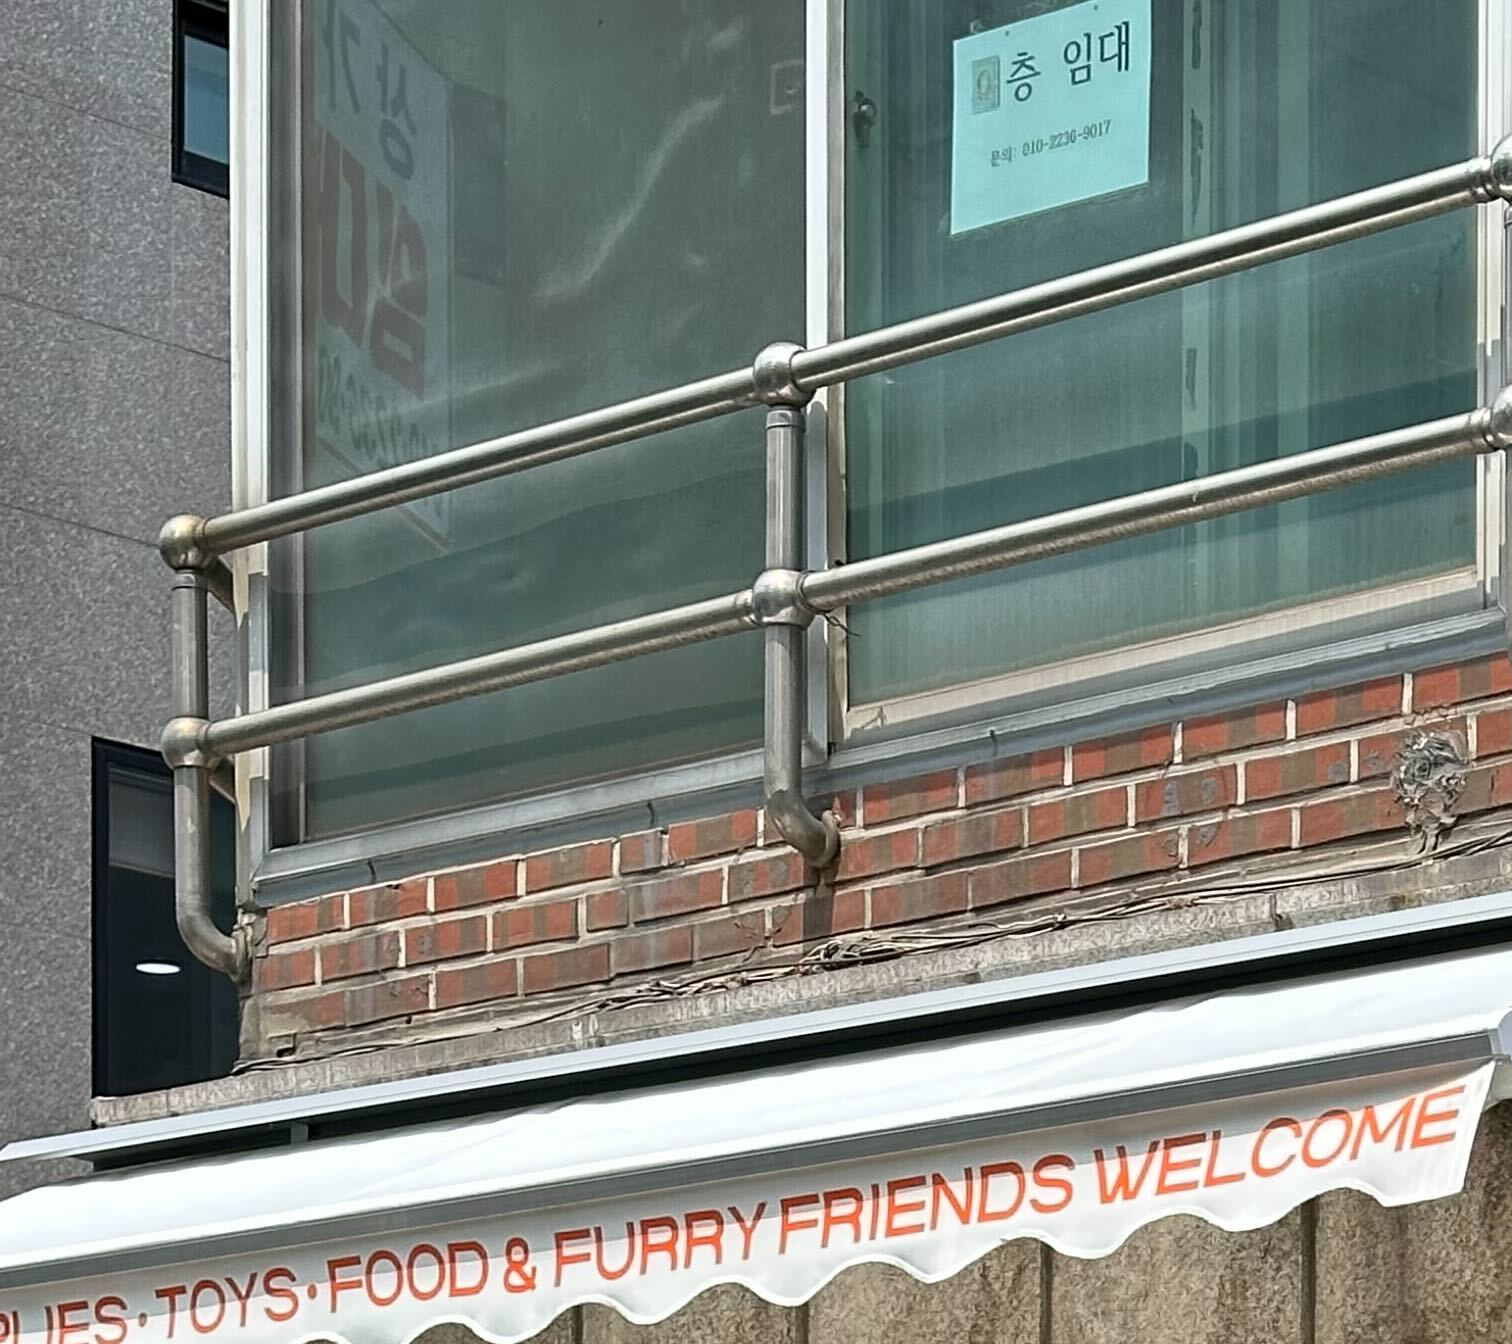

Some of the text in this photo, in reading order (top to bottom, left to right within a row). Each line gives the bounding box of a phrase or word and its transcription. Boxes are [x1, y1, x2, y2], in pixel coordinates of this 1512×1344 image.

[1063, 21, 1130, 86] 임대
[503, 1237, 538, 1294] &
[554, 1201, 767, 1288] FURRY
[778, 1153, 1076, 1256] FRIENDS
[1092, 1084, 1467, 1207] WELCOME
